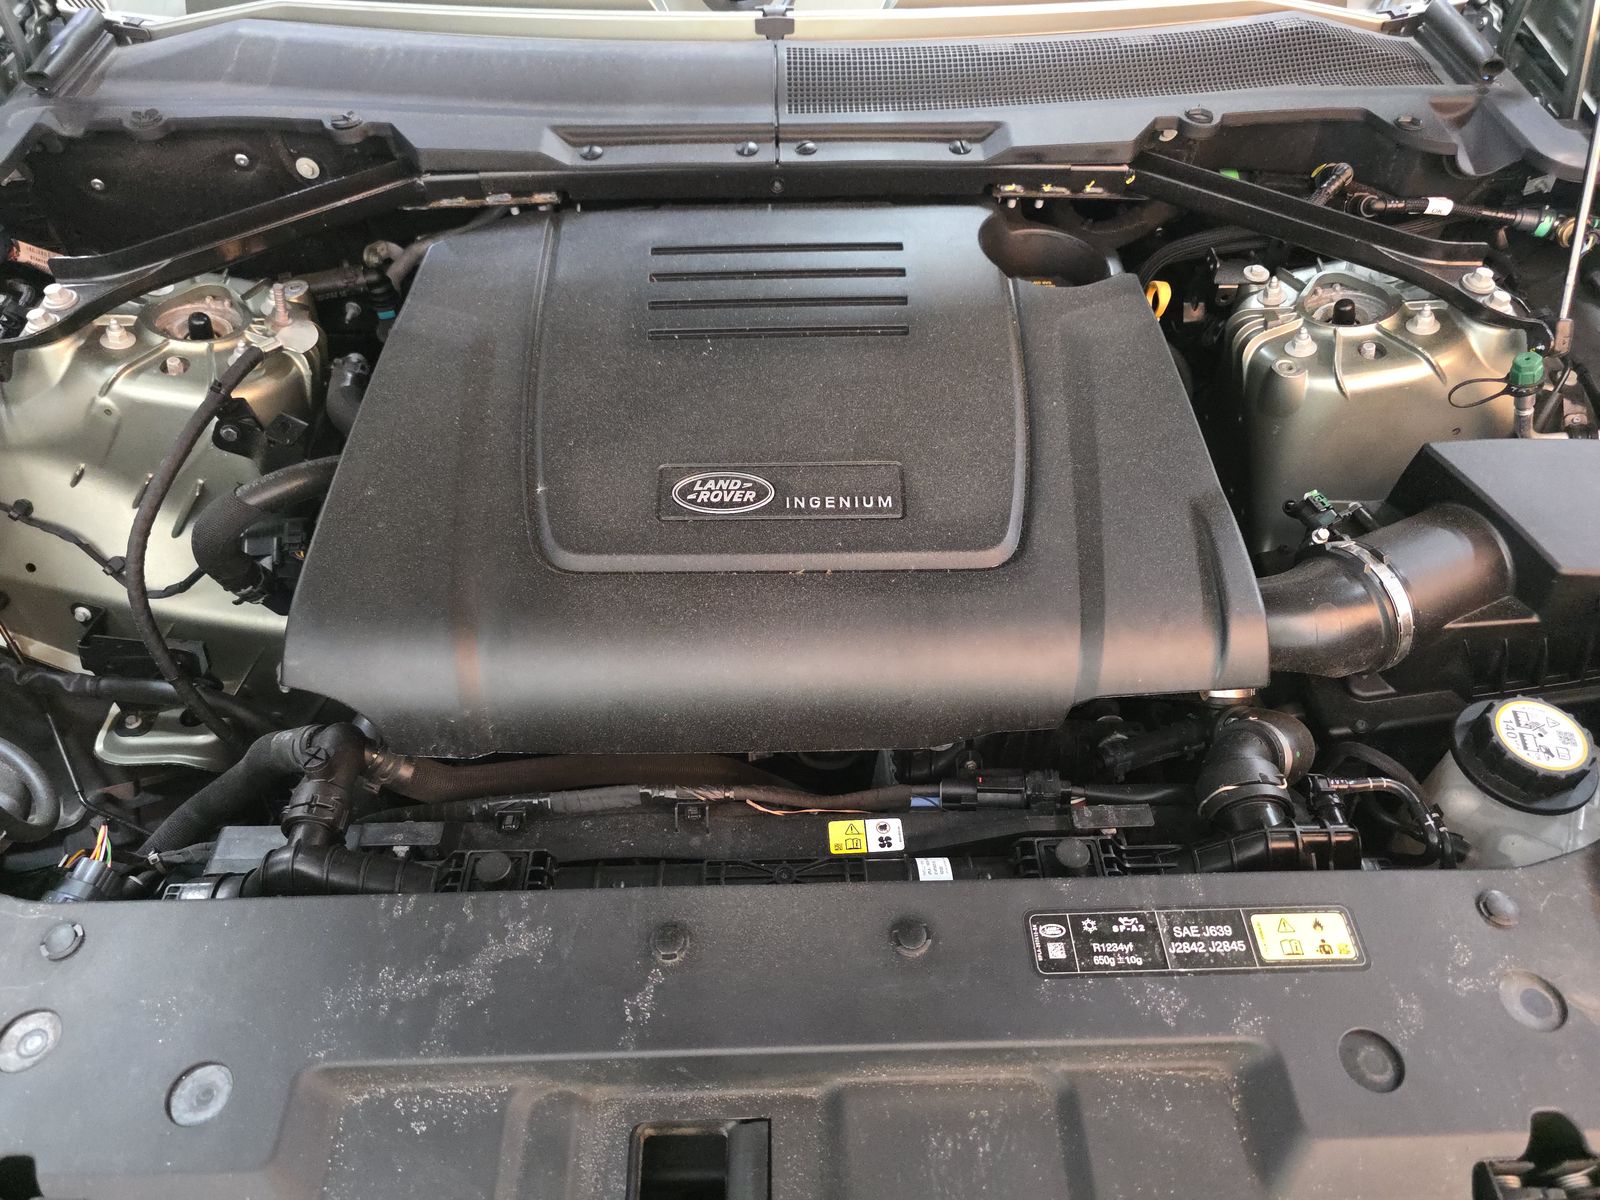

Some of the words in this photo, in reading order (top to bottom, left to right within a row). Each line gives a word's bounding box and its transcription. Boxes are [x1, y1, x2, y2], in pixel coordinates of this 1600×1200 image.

[693, 479, 742, 491] LAND
[696, 490, 757, 503] ROVER
[785, 495, 893, 509] INGENIUM
[1502, 719, 1517, 739] 140
[1112, 924, 1146, 933] SP-A2
[1173, 926, 1200, 938] SAE
[1202, 925, 1233, 937] J639
[1092, 942, 1134, 954] R1234yf
[1169, 941, 1206, 955] J2842
[1208, 940, 1246, 953] J2845
[1093, 956, 1116, 967] 650g
